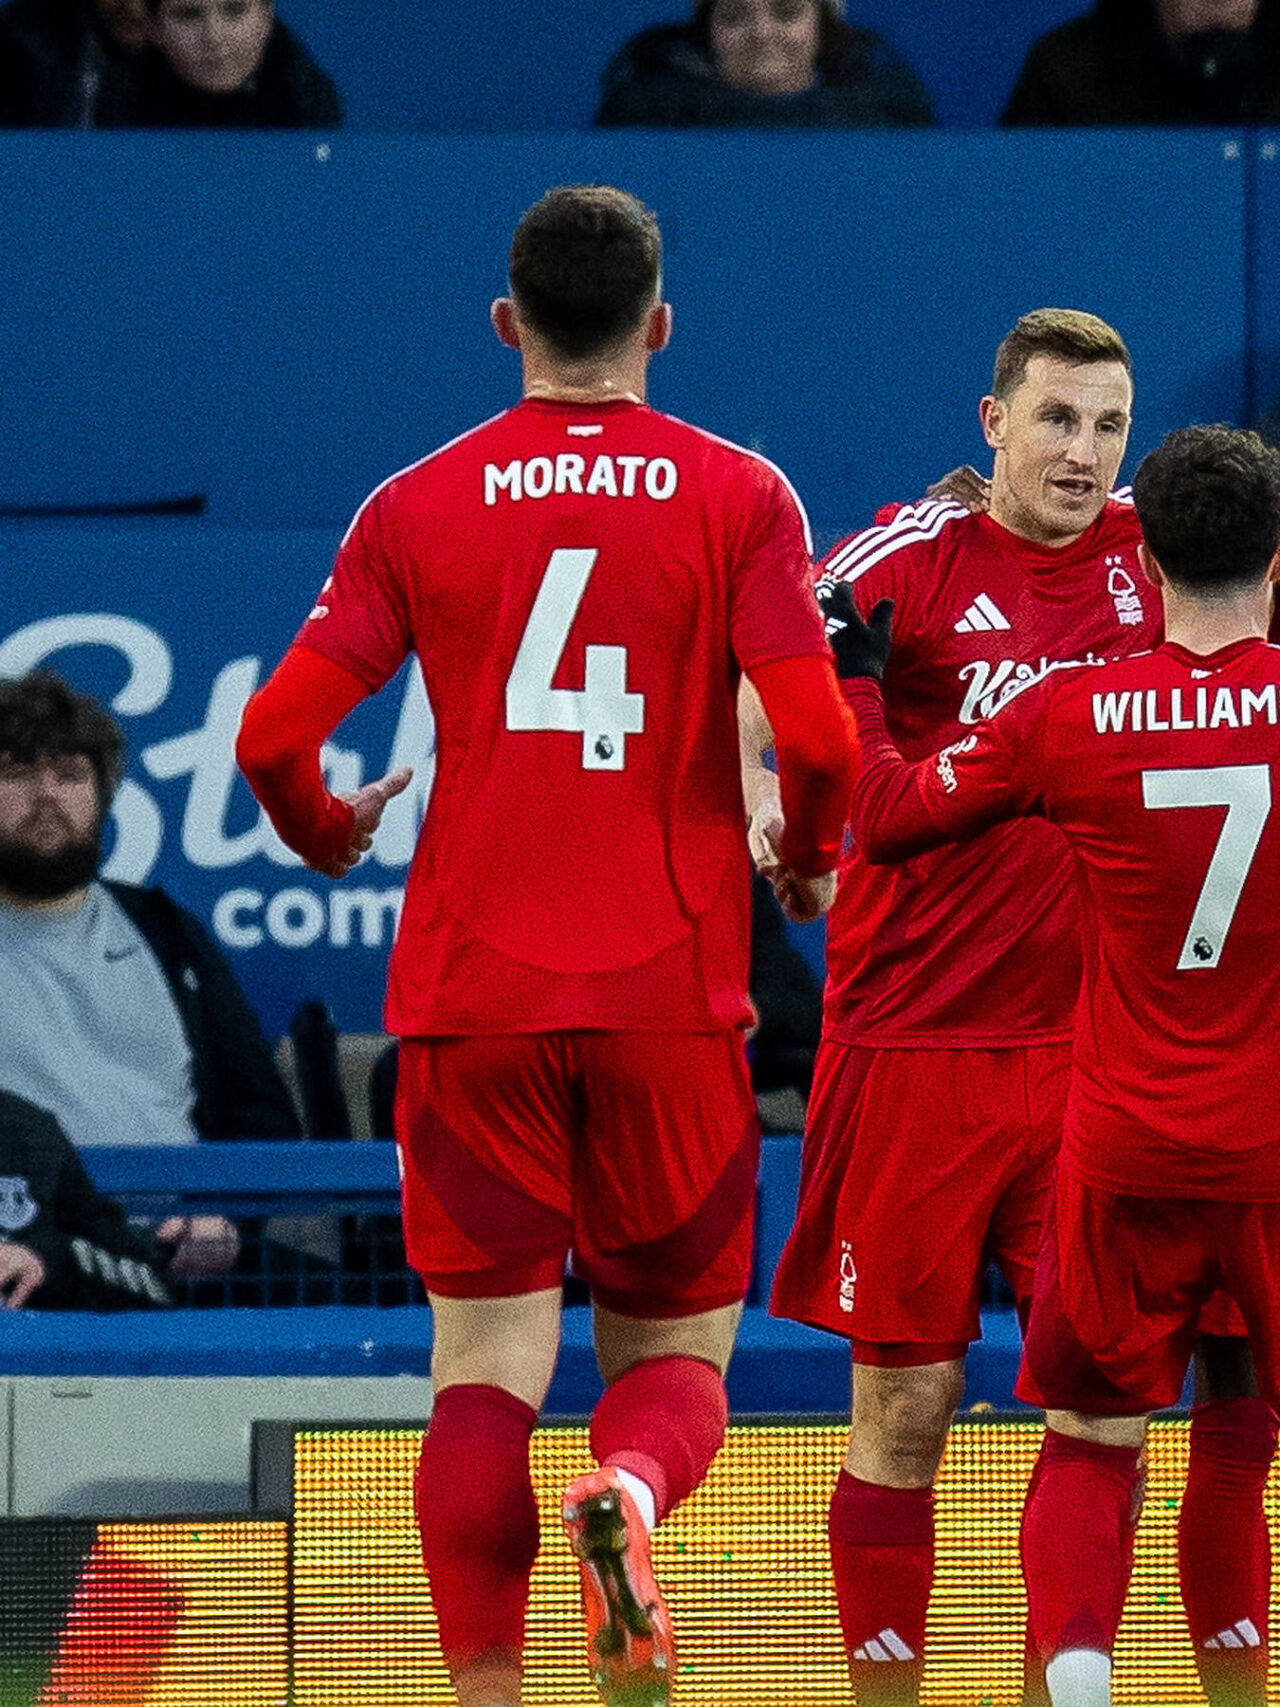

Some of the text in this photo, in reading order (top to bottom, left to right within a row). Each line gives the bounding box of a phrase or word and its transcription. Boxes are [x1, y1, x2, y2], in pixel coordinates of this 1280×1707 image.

[484, 453, 678, 506] MORATO
[506, 548, 644, 771] 4
[1142, 764, 1272, 970] 7
